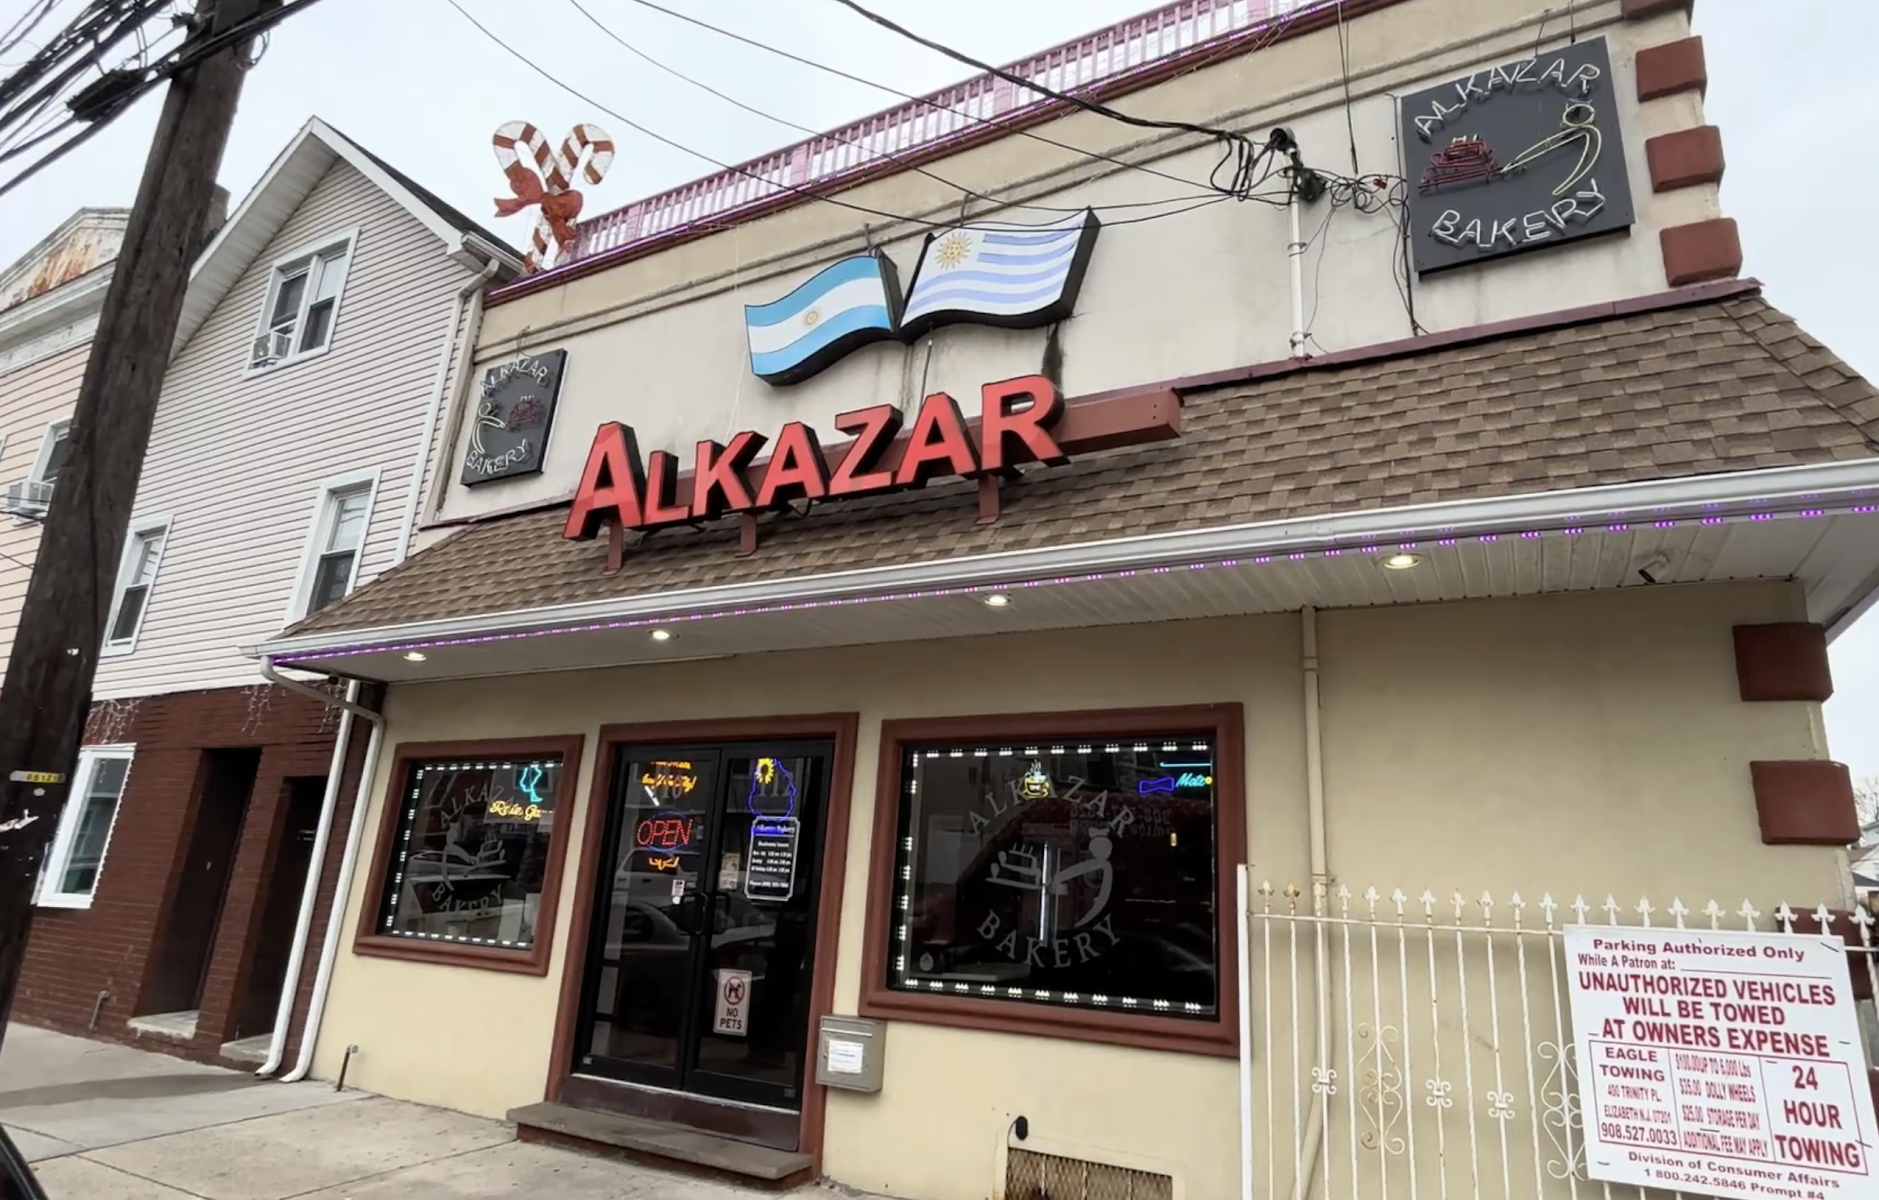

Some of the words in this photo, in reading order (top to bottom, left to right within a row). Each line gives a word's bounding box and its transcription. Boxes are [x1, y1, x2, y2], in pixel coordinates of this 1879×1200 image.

[1414, 57, 1600, 136] ALKAZAR
[1432, 178, 1606, 247] BAKERY
[480, 356, 548, 397] ALKAZAR
[466, 438, 527, 475] BAKERY
[562, 374, 1071, 541] ALKAZAR
[441, 781, 516, 829] ALKAZ
[637, 819, 693, 845] OPEN
[977, 909, 1121, 969] BAKERY
[1593, 938, 1656, 955] Parking
[1662, 941, 1757, 958] Authorized
[1763, 946, 1805, 962] Only
[1578, 953, 1608, 967] While
[1611, 954, 1619, 967] A
[1621, 955, 1657, 969] Patron
[1661, 958, 1676, 970] at:
[1578, 971, 1727, 999] UNAUTHORIZED
[1732, 979, 1836, 1006] VEHICLES
[719, 1017, 742, 1030] PETS
[726, 1006, 739, 1018] NO
[1622, 996, 1672, 1017] WILL
[1677, 999, 1704, 1020] BE
[1709, 1002, 1785, 1026] TOWED
[1602, 1018, 1626, 1039] AT
[1632, 1019, 1721, 1048] OWNERS
[1727, 1027, 1831, 1058] EXPENSE
[1605, 1046, 1658, 1062] EAGLE
[1599, 1064, 1665, 1082] TOWING
[1792, 1065, 1818, 1090] 24
[1621, 1085, 1649, 1101] TRINITY
[1705, 1080, 1727, 1100] DOLLY
[1728, 1083, 1756, 1103] WHEELS
[1604, 1104, 1639, 1120] ELIZABETH
[1706, 1107, 1735, 1128] STORAGE
[1735, 1110, 1747, 1129] PER
[1747, 1111, 1760, 1130] DAY
[1783, 1099, 1843, 1130] HOUR
[1601, 1122, 1677, 1146] 908.527.0033
[1683, 1130, 1720, 1151] ADDITIONAL
[1720, 1134, 1733, 1153] FEE
[1733, 1136, 1746, 1154] MAY
[1748, 1138, 1768, 1157] APPLY
[1774, 1134, 1861, 1168] TOWING
[1628, 1151, 1684, 1168] Division
[1688, 1159, 1702, 1170] of
[1707, 1161, 1782, 1180] Consumer
[1788, 1172, 1840, 1188] Affairs
[1644, 1168, 1651, 1177] 1
[1656, 1169, 1746, 1190] 800.242.5846
[1750, 1182, 1802, 1199] Prompt
[1807, 1190, 1825, 1200] #4
